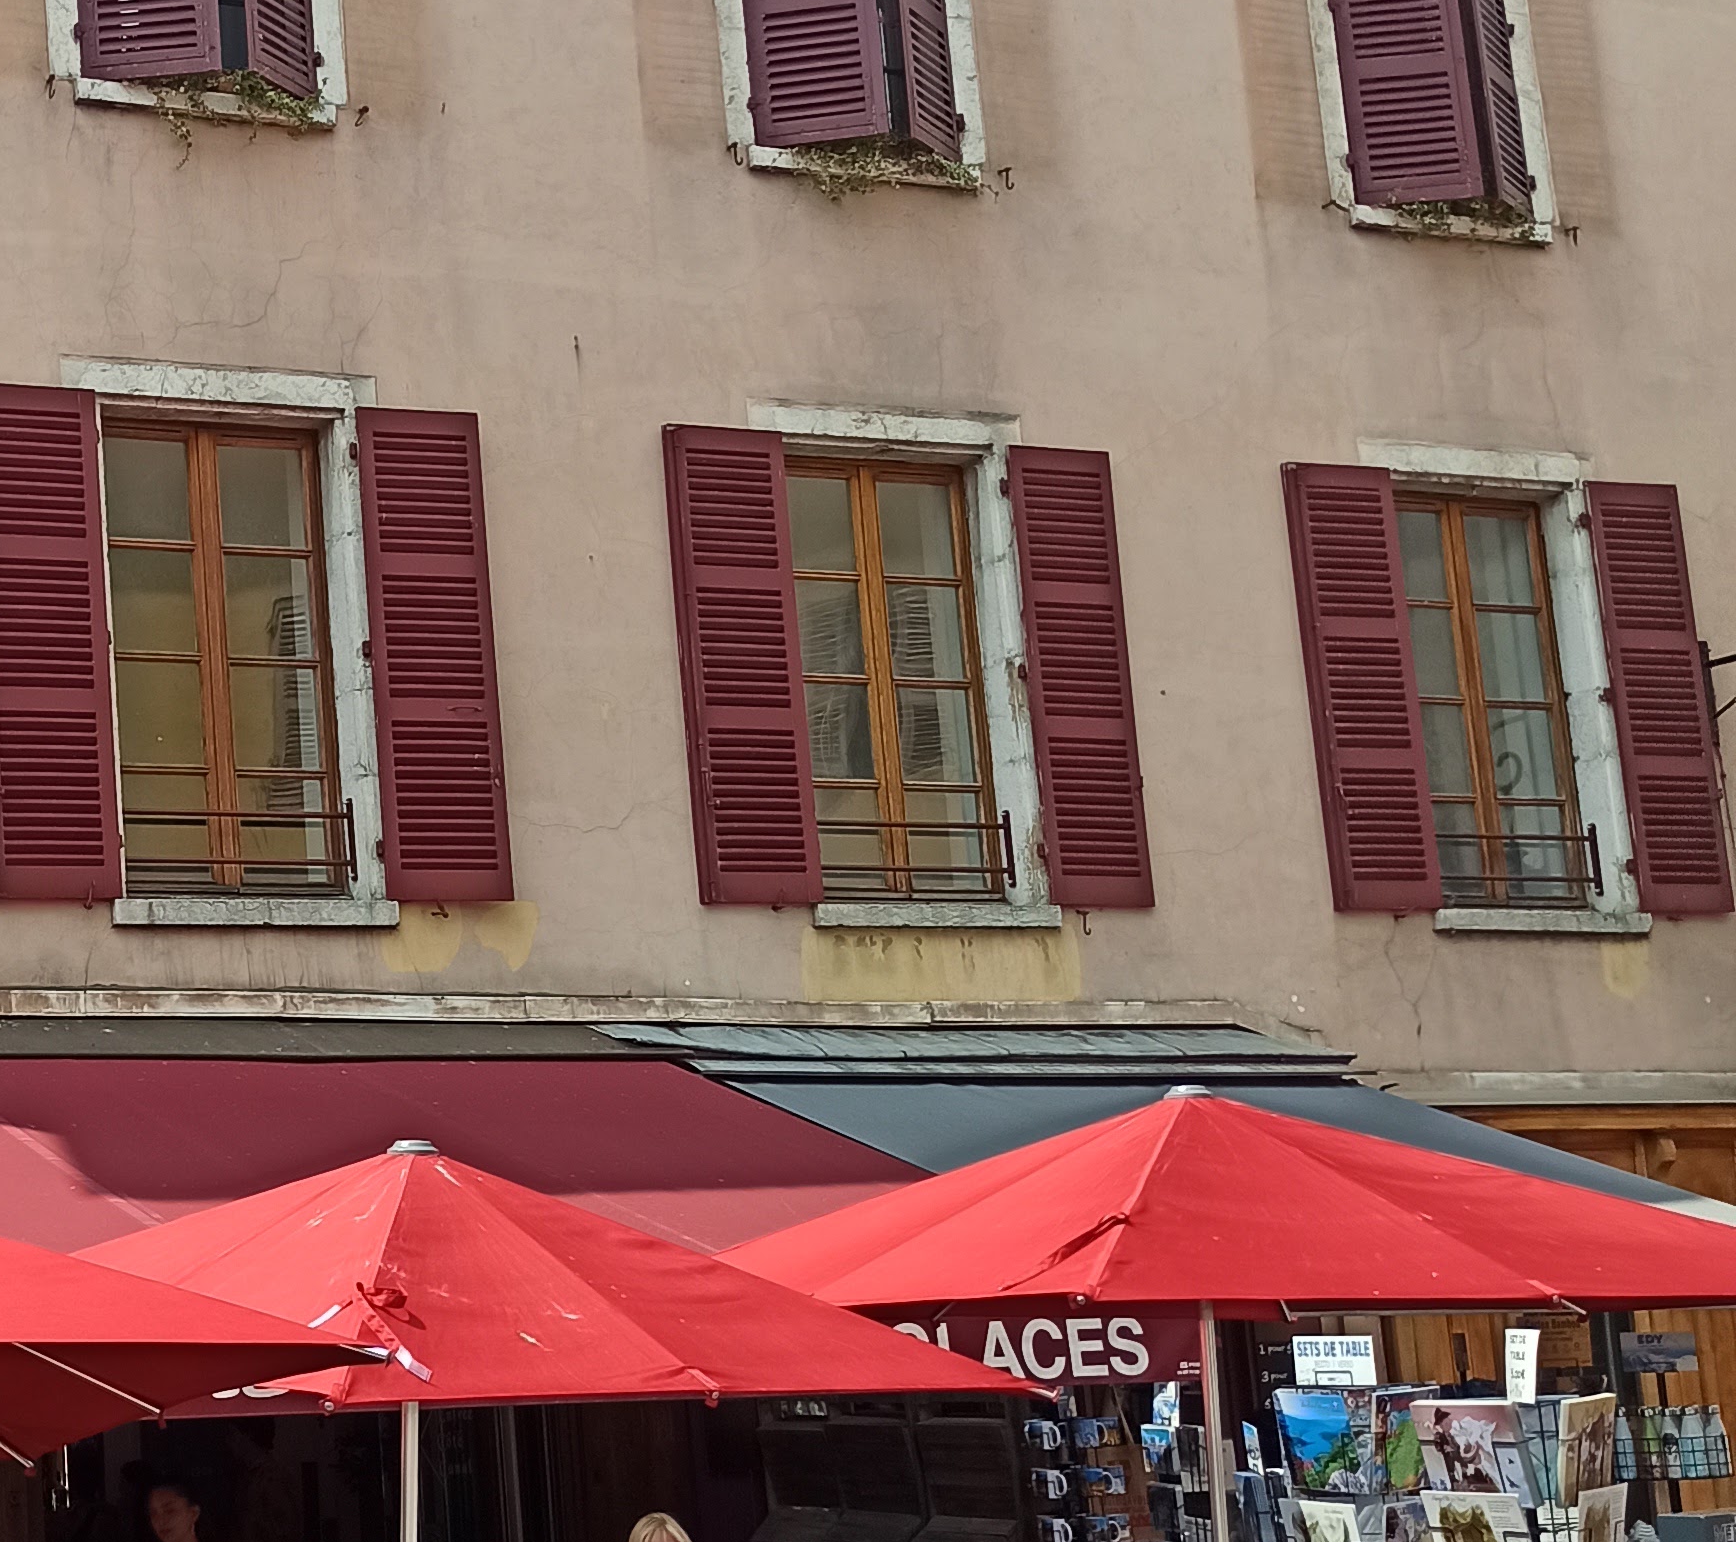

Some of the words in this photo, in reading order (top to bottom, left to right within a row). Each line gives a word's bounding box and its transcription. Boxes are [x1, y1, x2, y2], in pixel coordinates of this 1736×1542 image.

[1296, 1341, 1321, 1358] SETS
[1322, 1341, 1337, 1357] DE
[1338, 1341, 1371, 1357] TABLE
[1261, 1371, 1269, 1383] 3
[1270, 1371, 1288, 1384] pour
